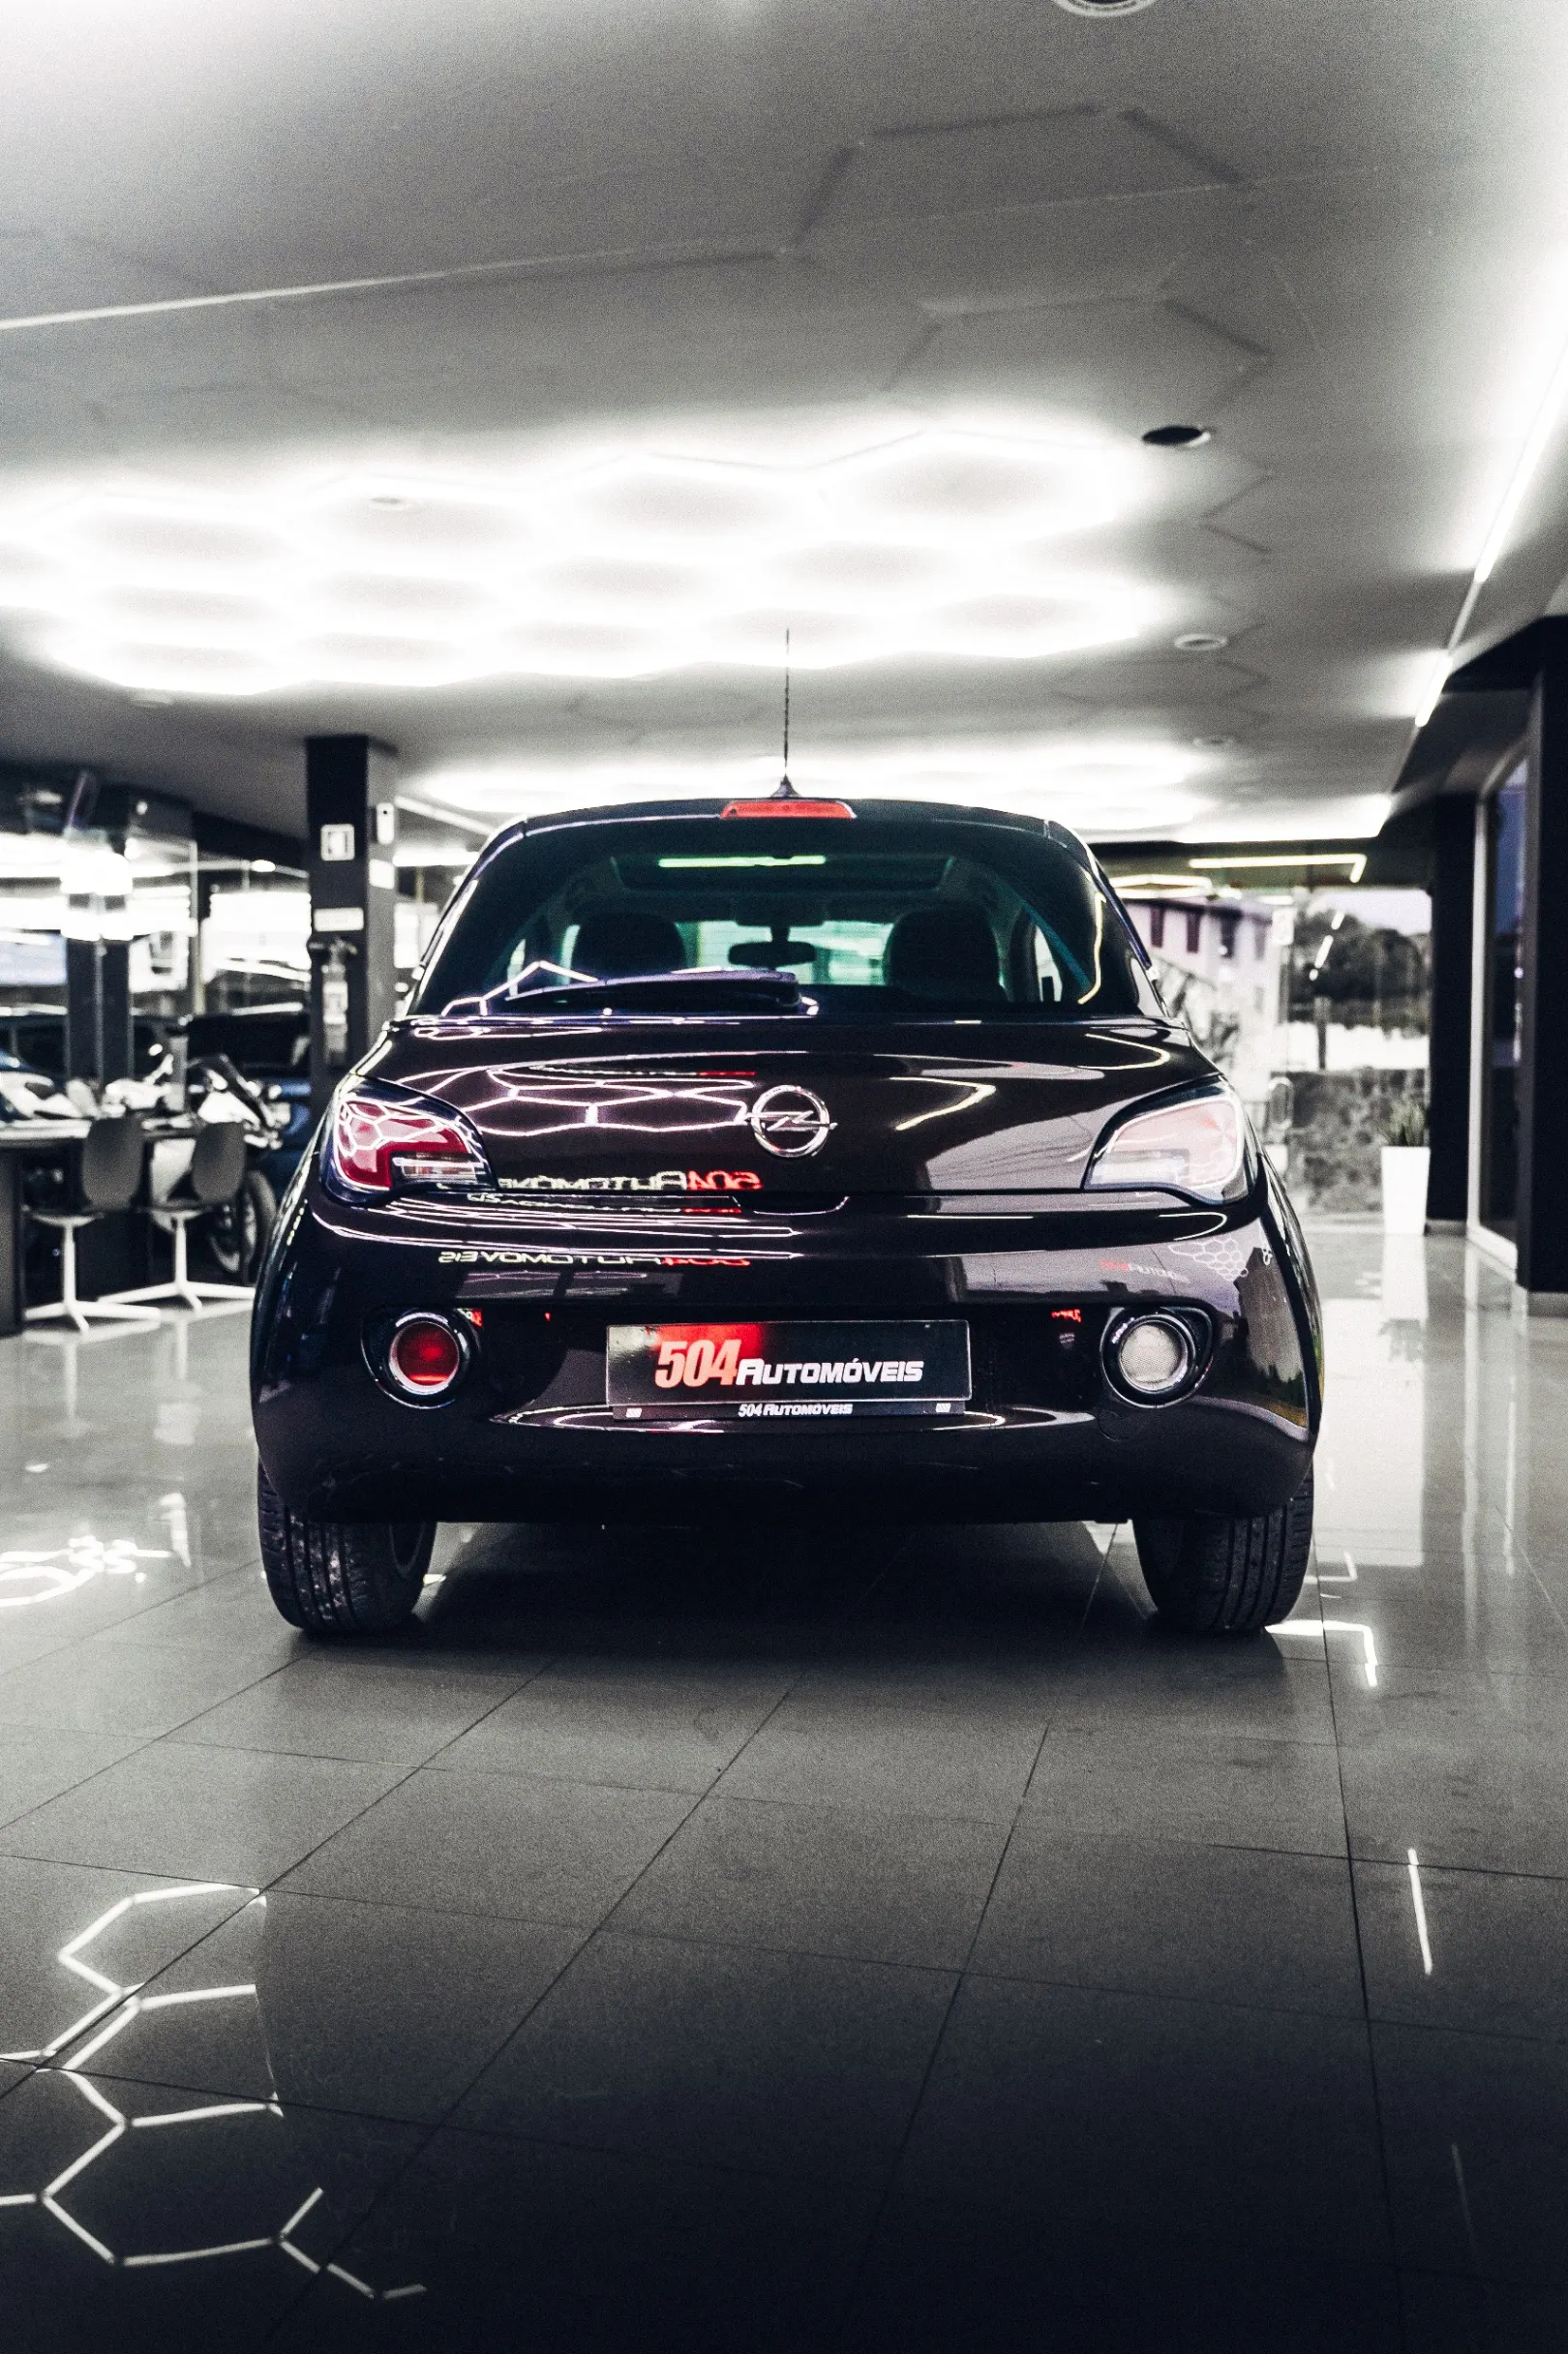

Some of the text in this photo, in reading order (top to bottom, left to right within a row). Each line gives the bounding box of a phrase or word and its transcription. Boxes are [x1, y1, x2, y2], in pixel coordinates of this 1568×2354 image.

[654, 1340, 924, 1388] 504 AUTOMÓVEIS
[739, 1403, 854, 1417] 504 AUTOMÓVEIS
